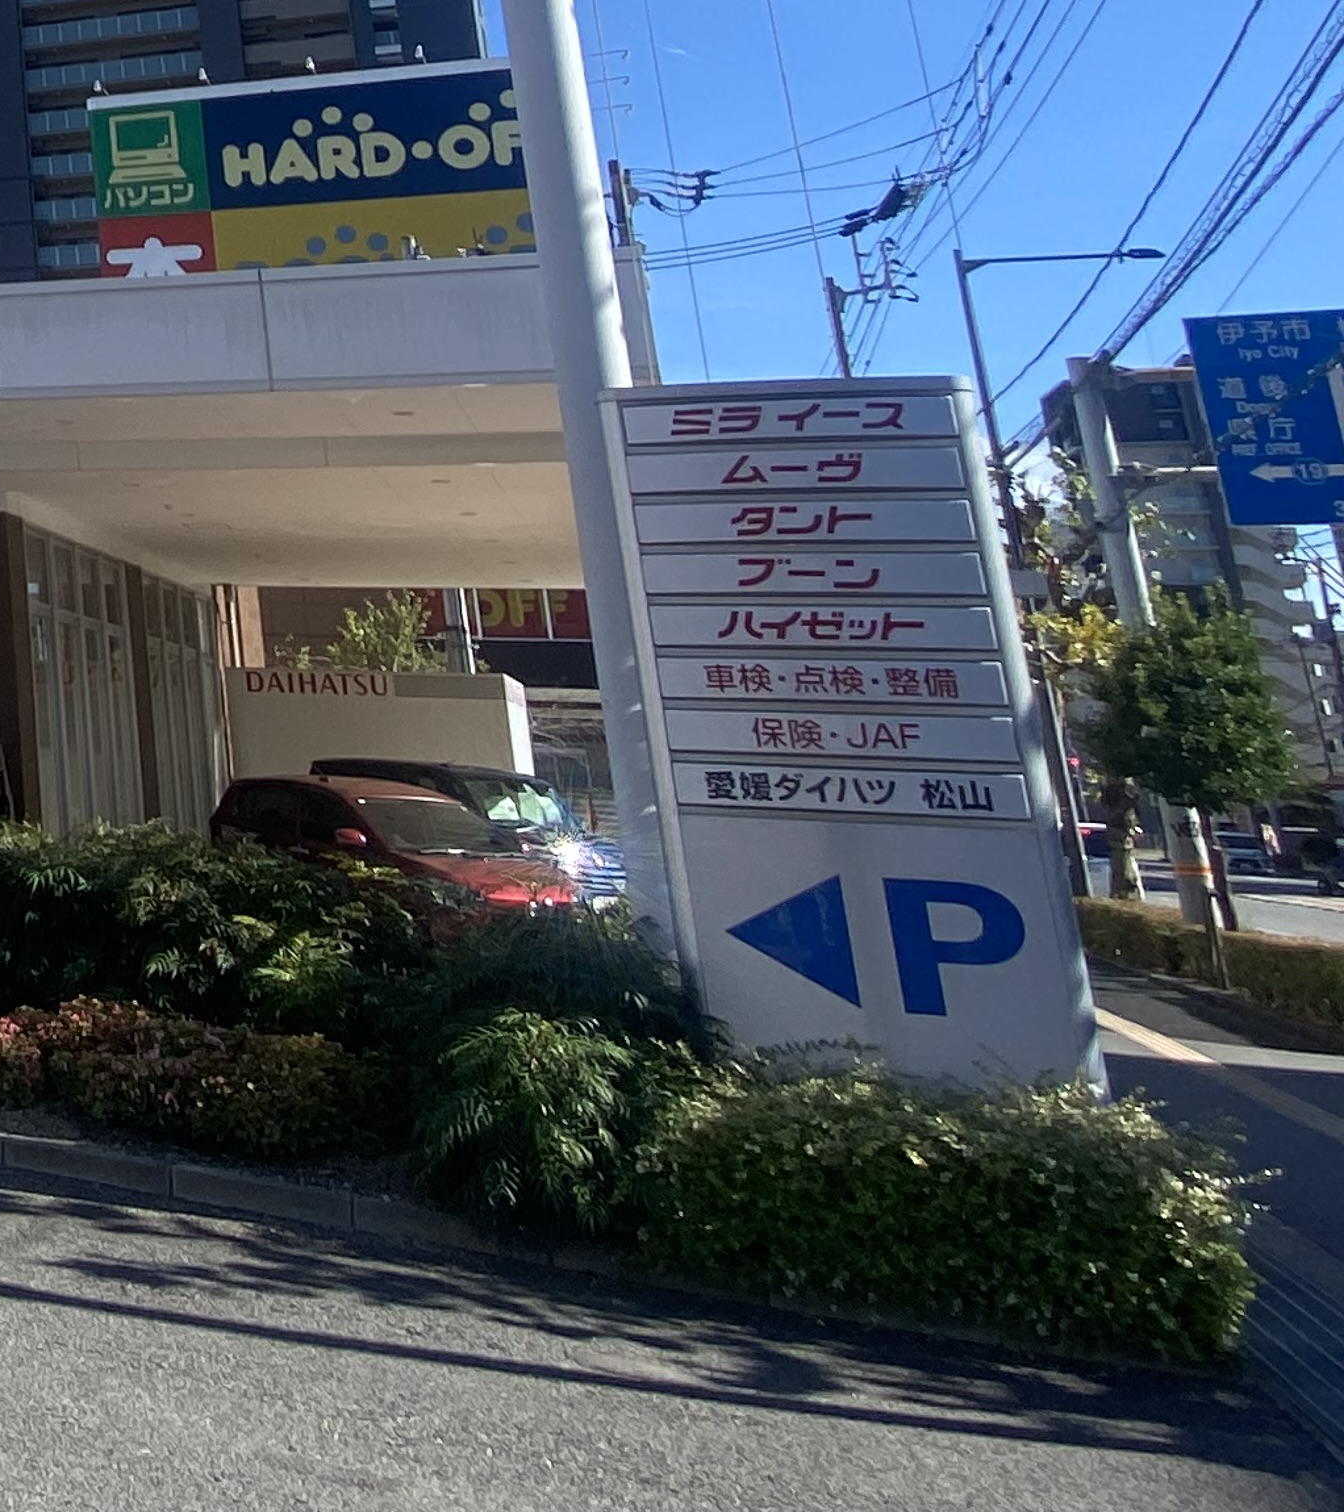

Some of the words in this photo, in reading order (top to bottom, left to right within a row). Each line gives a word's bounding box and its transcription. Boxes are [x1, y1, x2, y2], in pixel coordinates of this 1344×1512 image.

[104, 182, 194, 208] パソコン
[1217, 320, 1311, 345] 伊予市
[1267, 345, 1300, 360] City
[721, 453, 863, 484] ムーヴ
[730, 506, 873, 537] タント
[737, 557, 880, 588] ブーン
[717, 610, 925, 641] ハイゼット
[244, 670, 388, 697] DAIHATSU
[704, 770, 897, 805] 愛媛ダイハツ
[919, 777, 995, 813] 松山
[882, 876, 1026, 1017] P
